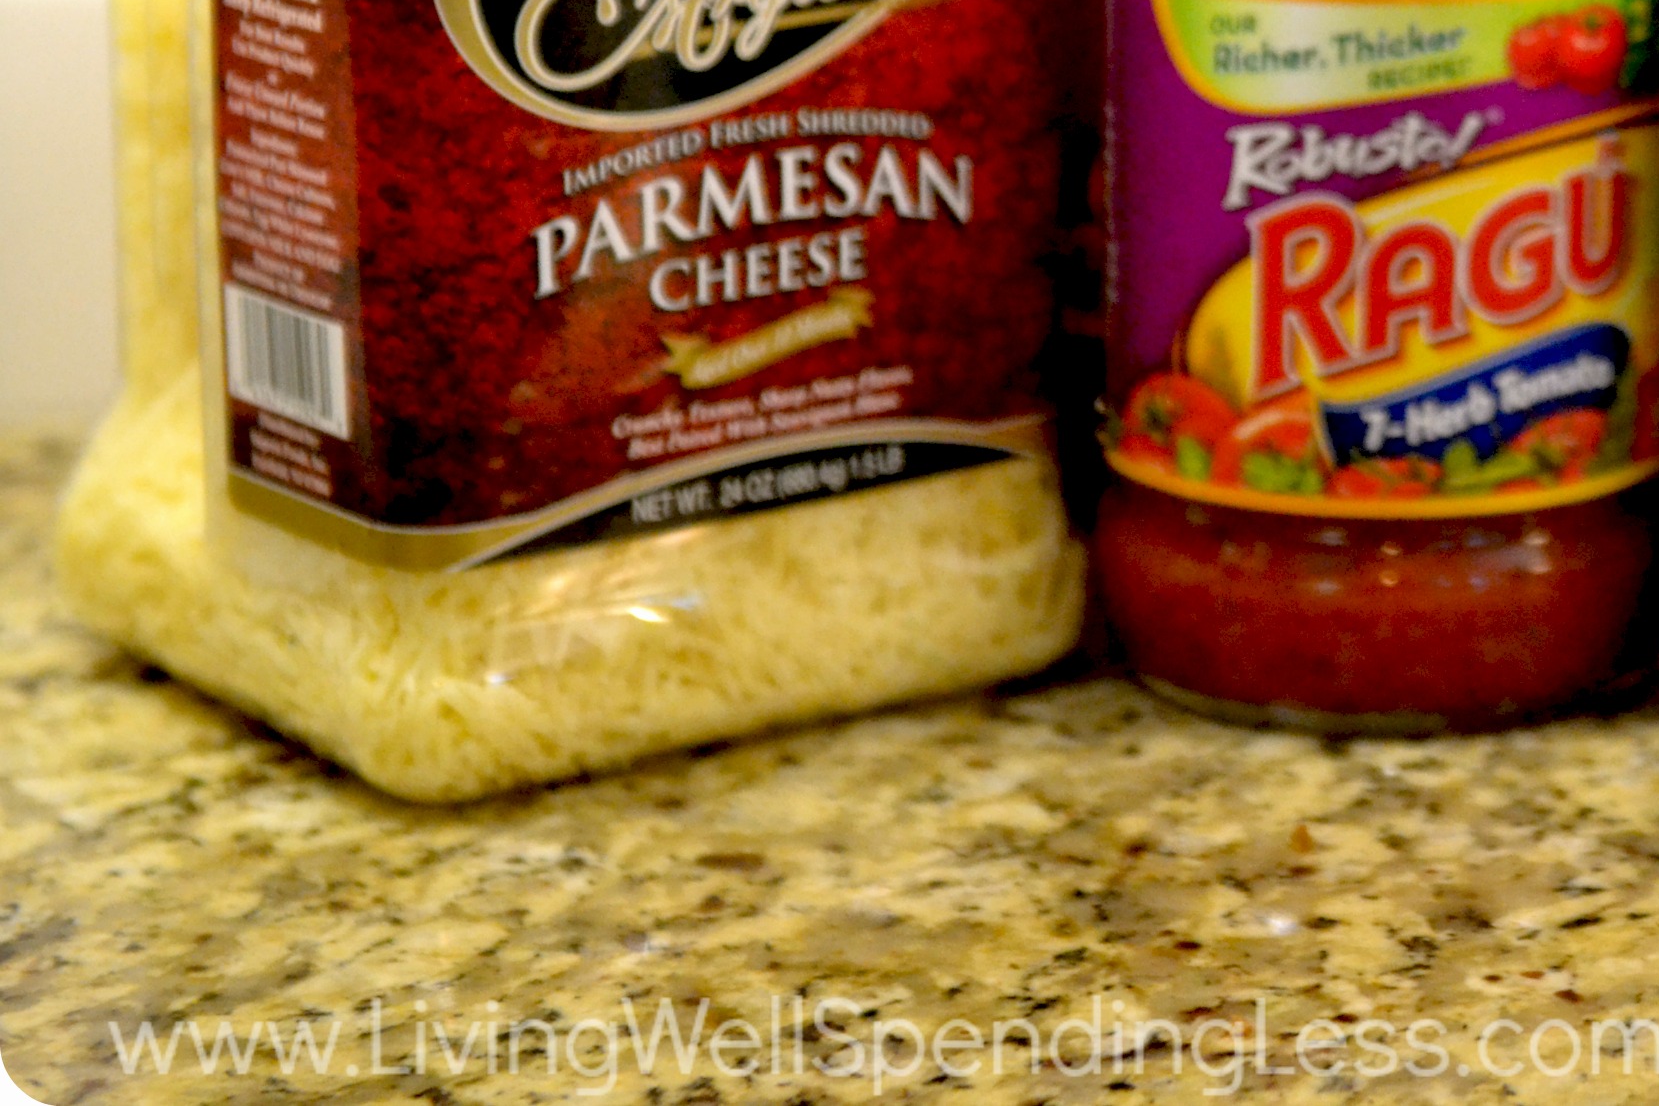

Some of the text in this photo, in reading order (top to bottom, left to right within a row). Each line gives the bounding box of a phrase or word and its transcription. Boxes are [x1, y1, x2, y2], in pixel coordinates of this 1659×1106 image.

[1209, 13, 1257, 35] OUR
[1332, 23, 1467, 67] Thicker
[562, 106, 935, 197] IMPORTED FRESH SHREDDED
[1220, 110, 1488, 213] Robusto!
[530, 143, 975, 301] PARMESAN
[648, 228, 868, 313] CHEESE
[1358, 350, 1616, 453] 7-Herb Tomato
